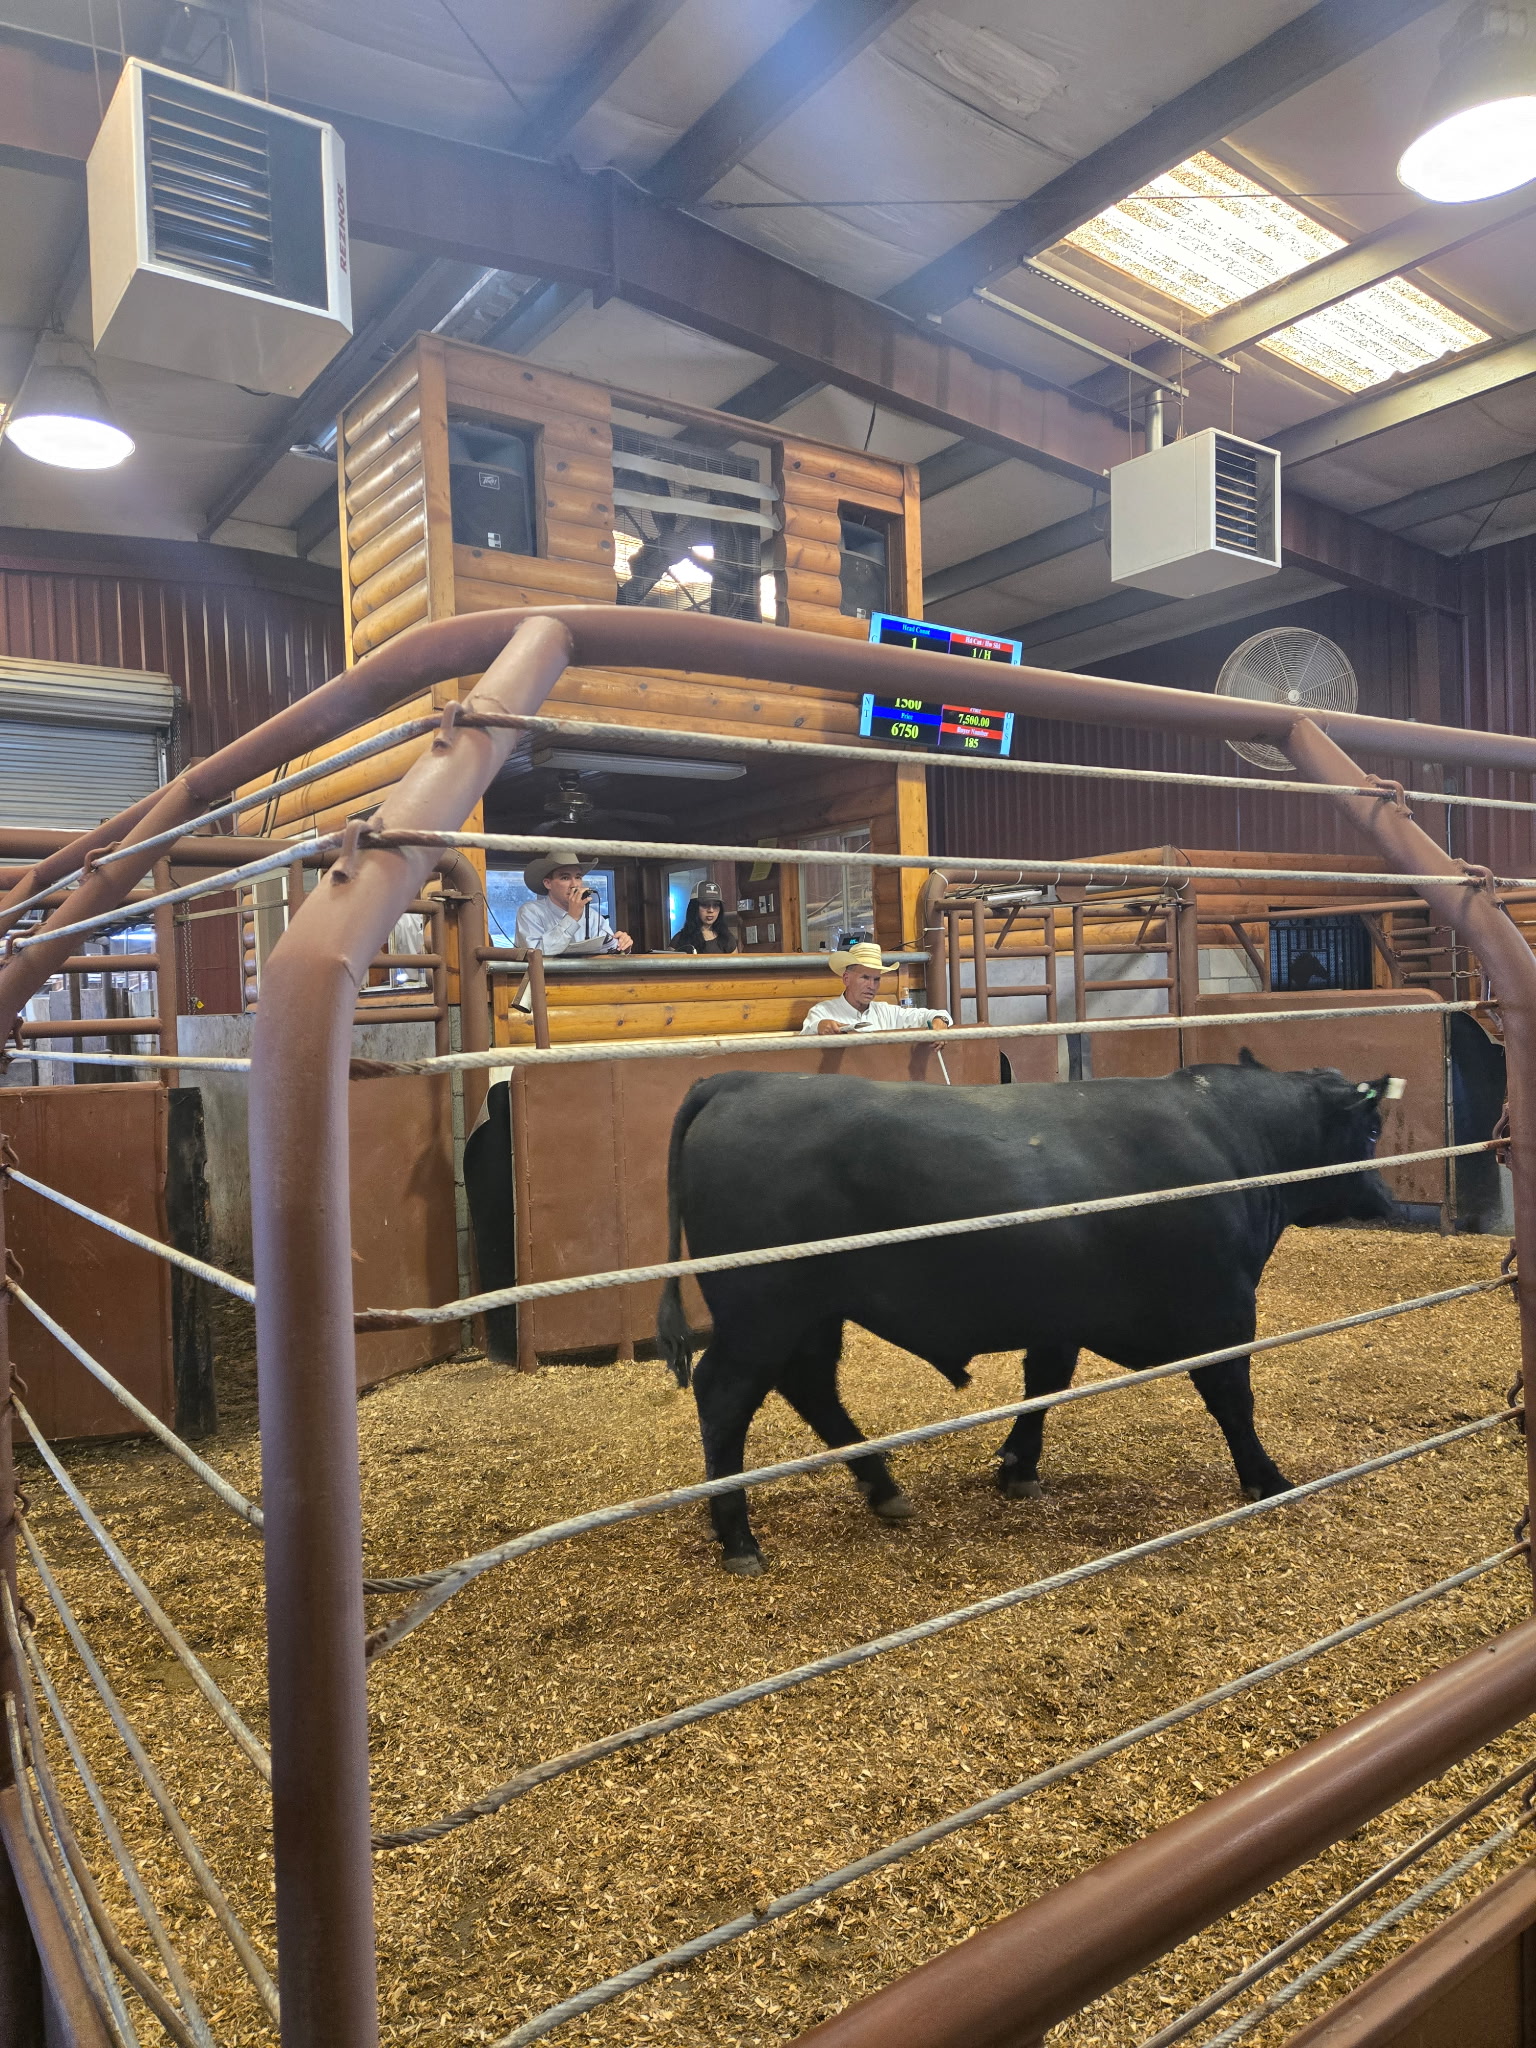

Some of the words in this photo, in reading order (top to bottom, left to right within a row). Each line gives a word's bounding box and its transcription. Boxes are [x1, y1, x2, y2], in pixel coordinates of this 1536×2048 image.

[336, 182, 348, 274] REZNOR
[902, 624, 915, 633] Head
[916, 626, 931, 635] Count
[900, 712, 914, 720] Price
[958, 713, 990, 728] 7,500.00
[891, 722, 919, 739] 6750
[956, 726, 970, 735] Buyer
[970, 728, 989, 737] Number
[964, 736, 979, 749] 185
